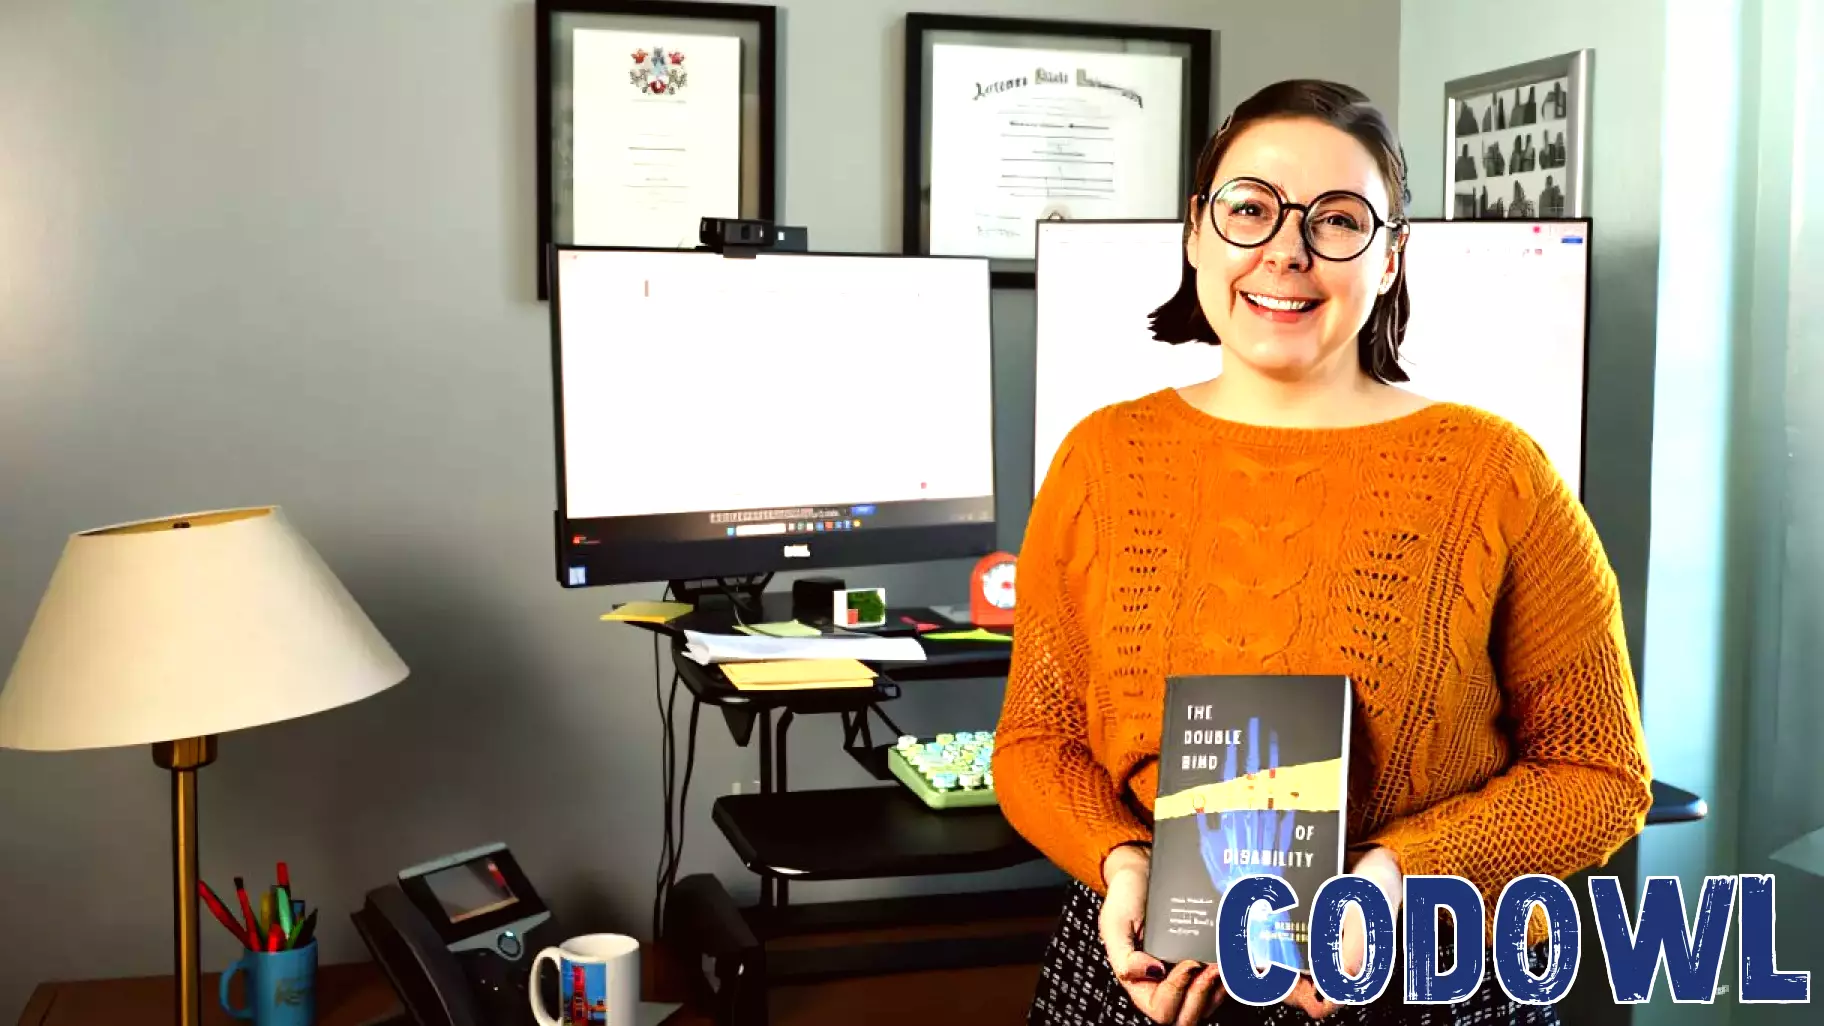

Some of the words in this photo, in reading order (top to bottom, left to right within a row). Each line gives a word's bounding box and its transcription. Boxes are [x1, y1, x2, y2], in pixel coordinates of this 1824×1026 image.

[1187, 704, 1213, 721] THE
[1184, 729, 1242, 745] DOUBLE
[1295, 825, 1315, 841] OF
[1223, 848, 1314, 868] DISABILITY
